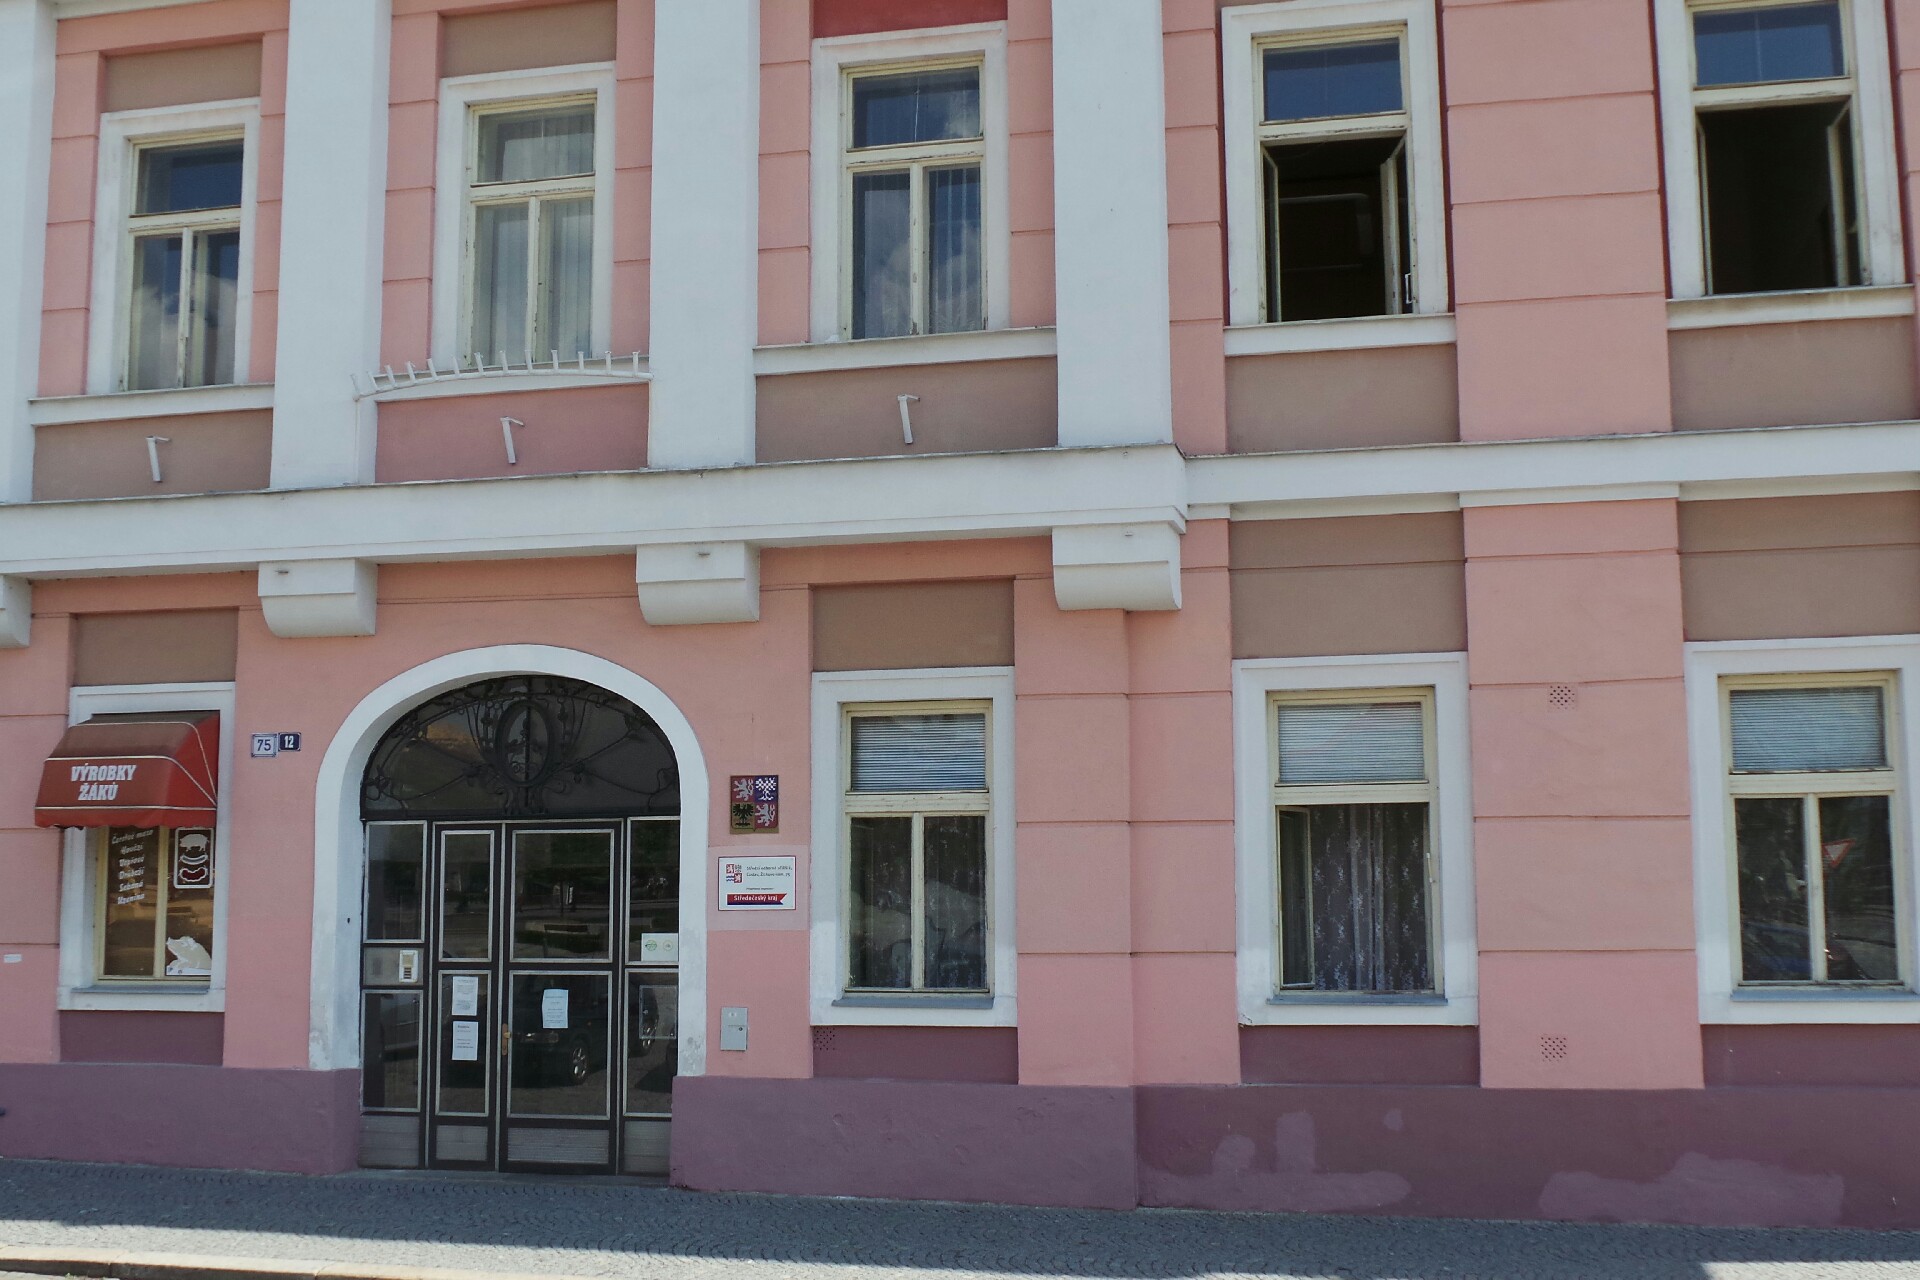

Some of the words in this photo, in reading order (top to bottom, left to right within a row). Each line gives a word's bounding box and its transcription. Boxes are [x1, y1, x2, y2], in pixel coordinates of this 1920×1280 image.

[257, 739, 271, 751] 75
[284, 735, 294, 748] 12
[71, 763, 137, 781] VÝROBKY
[78, 782, 119, 801] ŽÁKŮ
[733, 894, 767, 902] Středočeský
[767, 894, 778, 902] kraj
